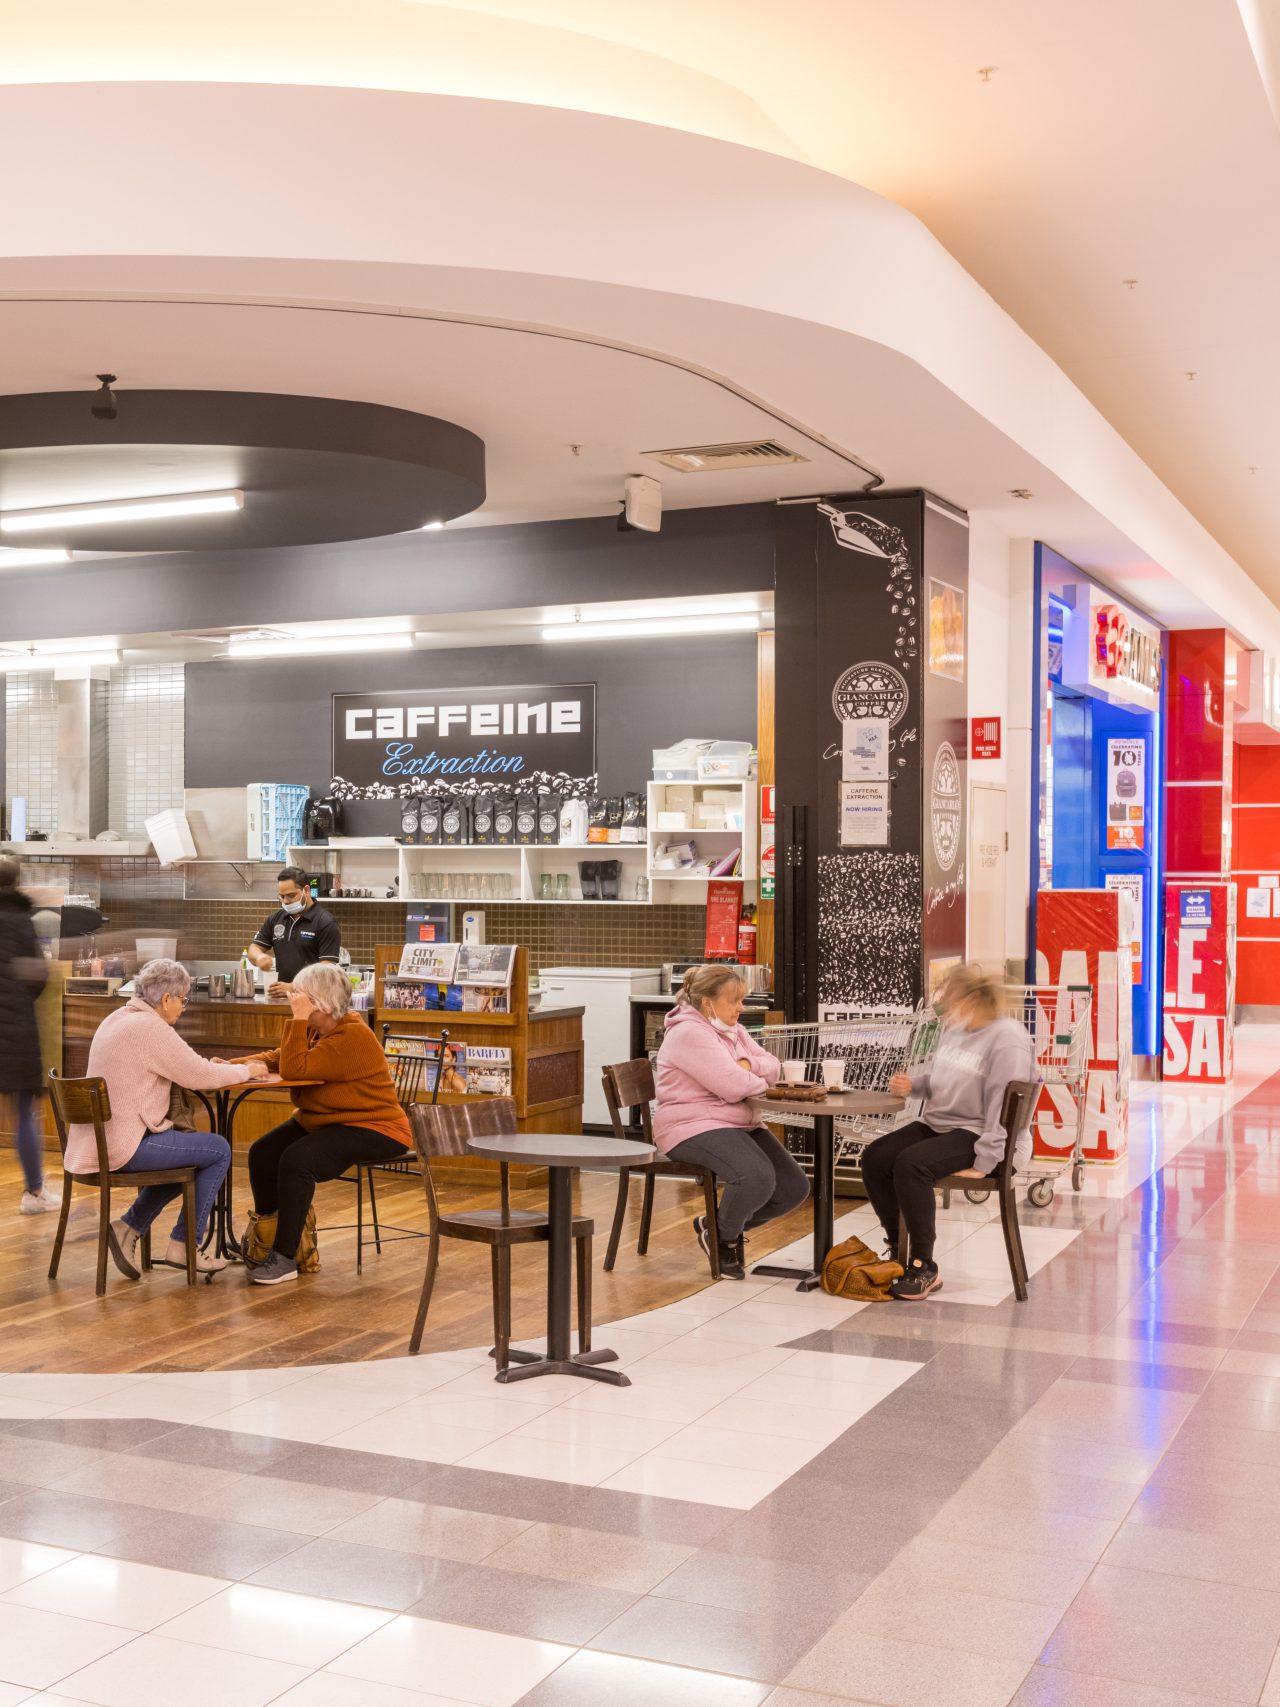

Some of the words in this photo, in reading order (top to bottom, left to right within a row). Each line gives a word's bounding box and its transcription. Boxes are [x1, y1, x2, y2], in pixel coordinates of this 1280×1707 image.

[841, 667, 868, 689] SIGNATURE
[870, 667, 890, 676] BLEND
[837, 692, 903, 702] GIANCARLO
[900, 728, 917, 748] life
[382, 742, 524, 776] Extraction
[933, 799, 960, 809] GIANCARLO
[413, 949, 435, 958] CITY
[411, 957, 438, 967] LIMIT
